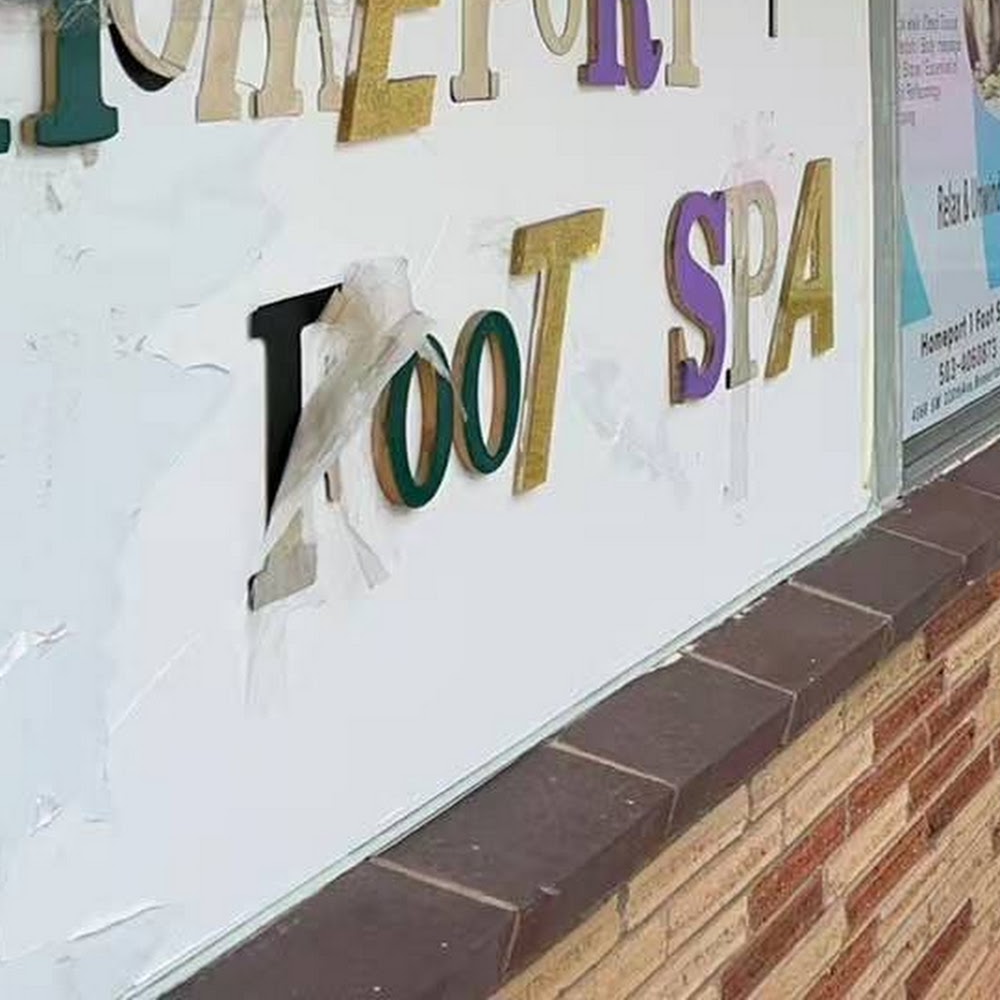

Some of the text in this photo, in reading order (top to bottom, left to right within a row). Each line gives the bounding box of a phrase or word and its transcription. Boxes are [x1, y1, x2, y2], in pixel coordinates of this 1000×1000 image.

[937, 178, 962, 230] Relax
[664, 158, 835, 405] SPA
[920, 315, 967, 358] Homeport
[975, 304, 995, 333] Foot
